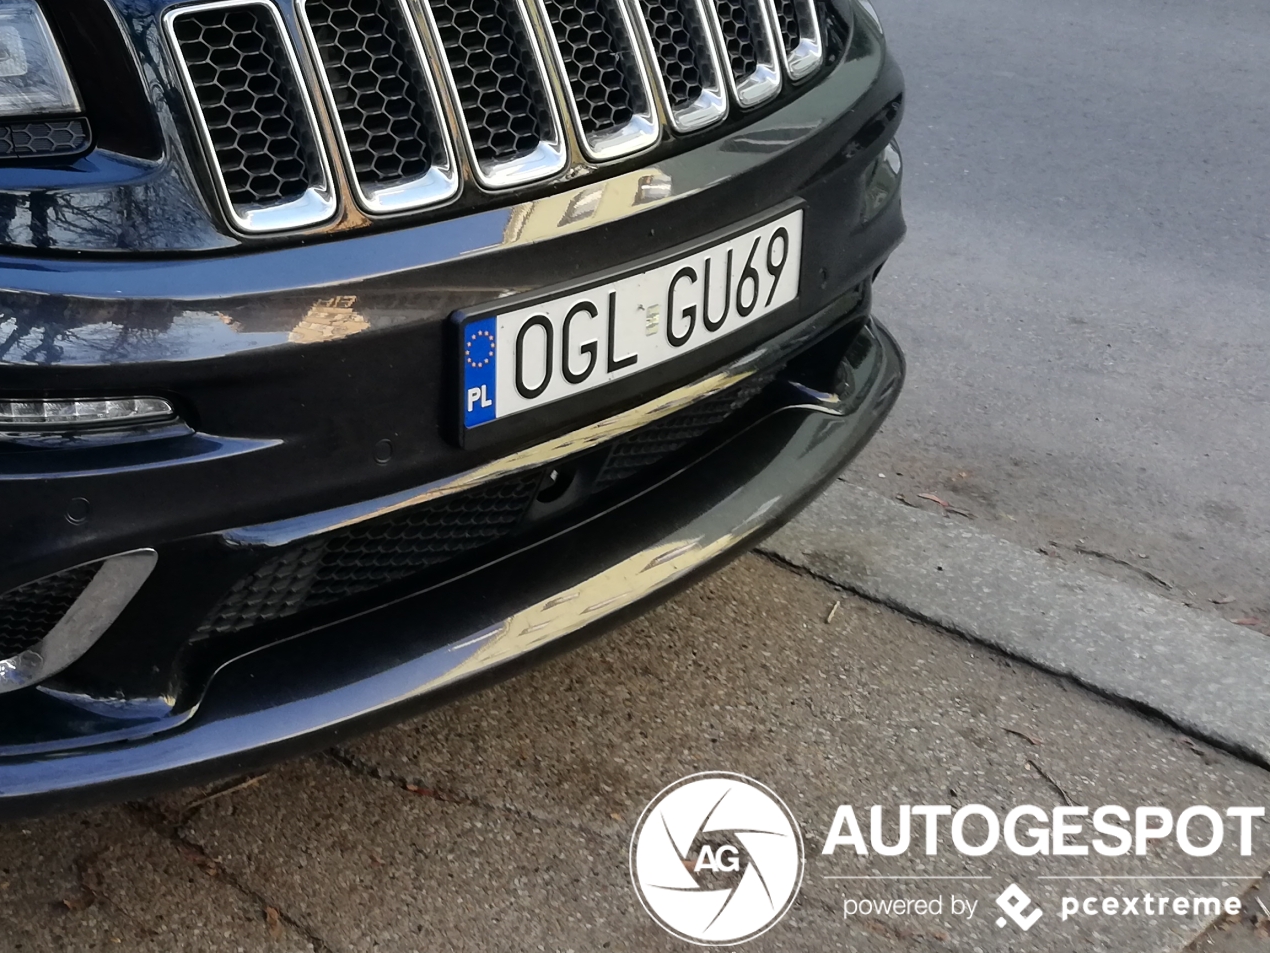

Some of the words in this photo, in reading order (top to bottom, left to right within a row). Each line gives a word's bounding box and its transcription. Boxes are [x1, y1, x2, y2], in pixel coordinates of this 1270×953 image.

[514, 291, 639, 399] OGL
[666, 226, 790, 347] GU69
[467, 384, 492, 412] PL
